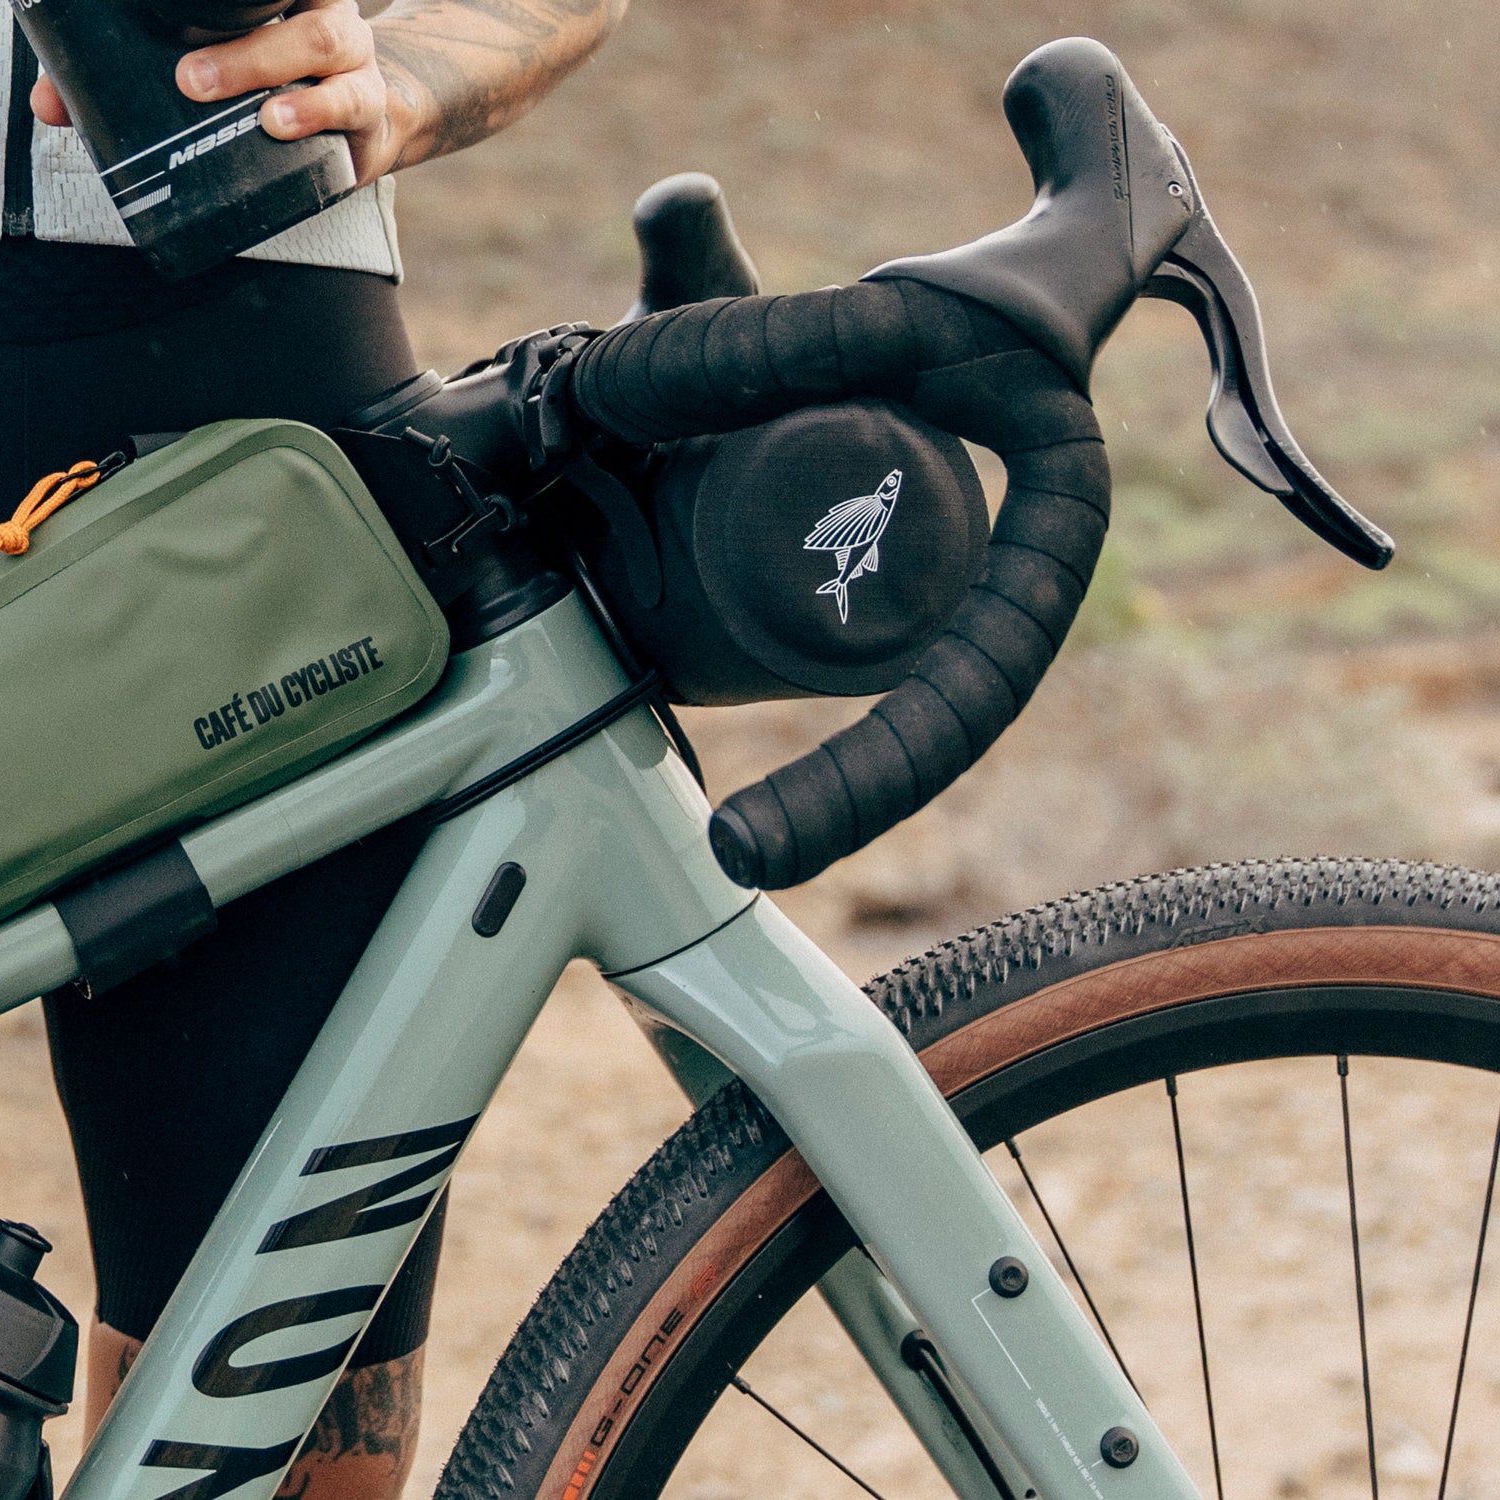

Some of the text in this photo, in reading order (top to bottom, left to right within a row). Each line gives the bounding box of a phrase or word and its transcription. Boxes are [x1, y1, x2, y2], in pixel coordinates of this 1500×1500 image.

[193, 636, 384, 750] CAFÉ DU CYCLISTE
[590, 1308, 684, 1447] G-ONE
